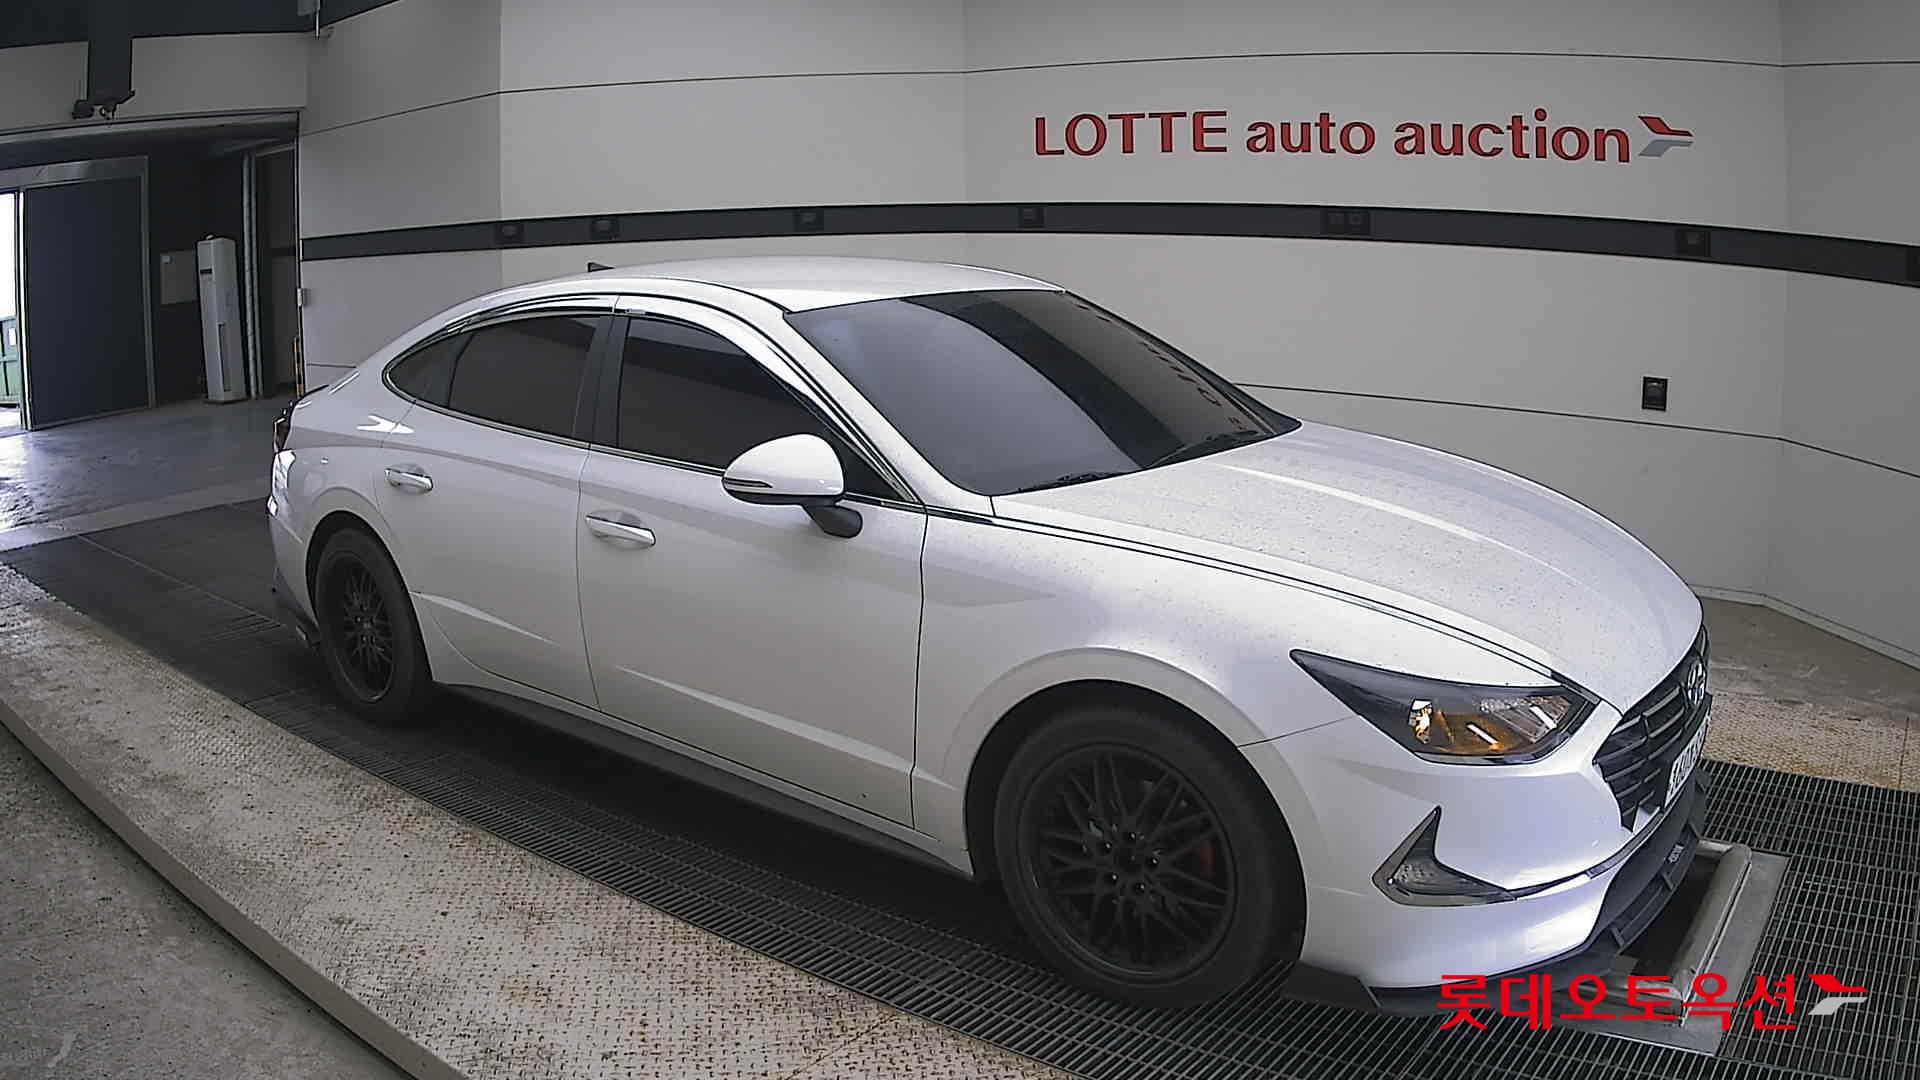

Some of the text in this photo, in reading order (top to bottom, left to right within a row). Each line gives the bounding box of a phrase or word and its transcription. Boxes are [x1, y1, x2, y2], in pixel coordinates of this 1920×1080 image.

[1034, 108, 1631, 163] LOTTE auto auction
